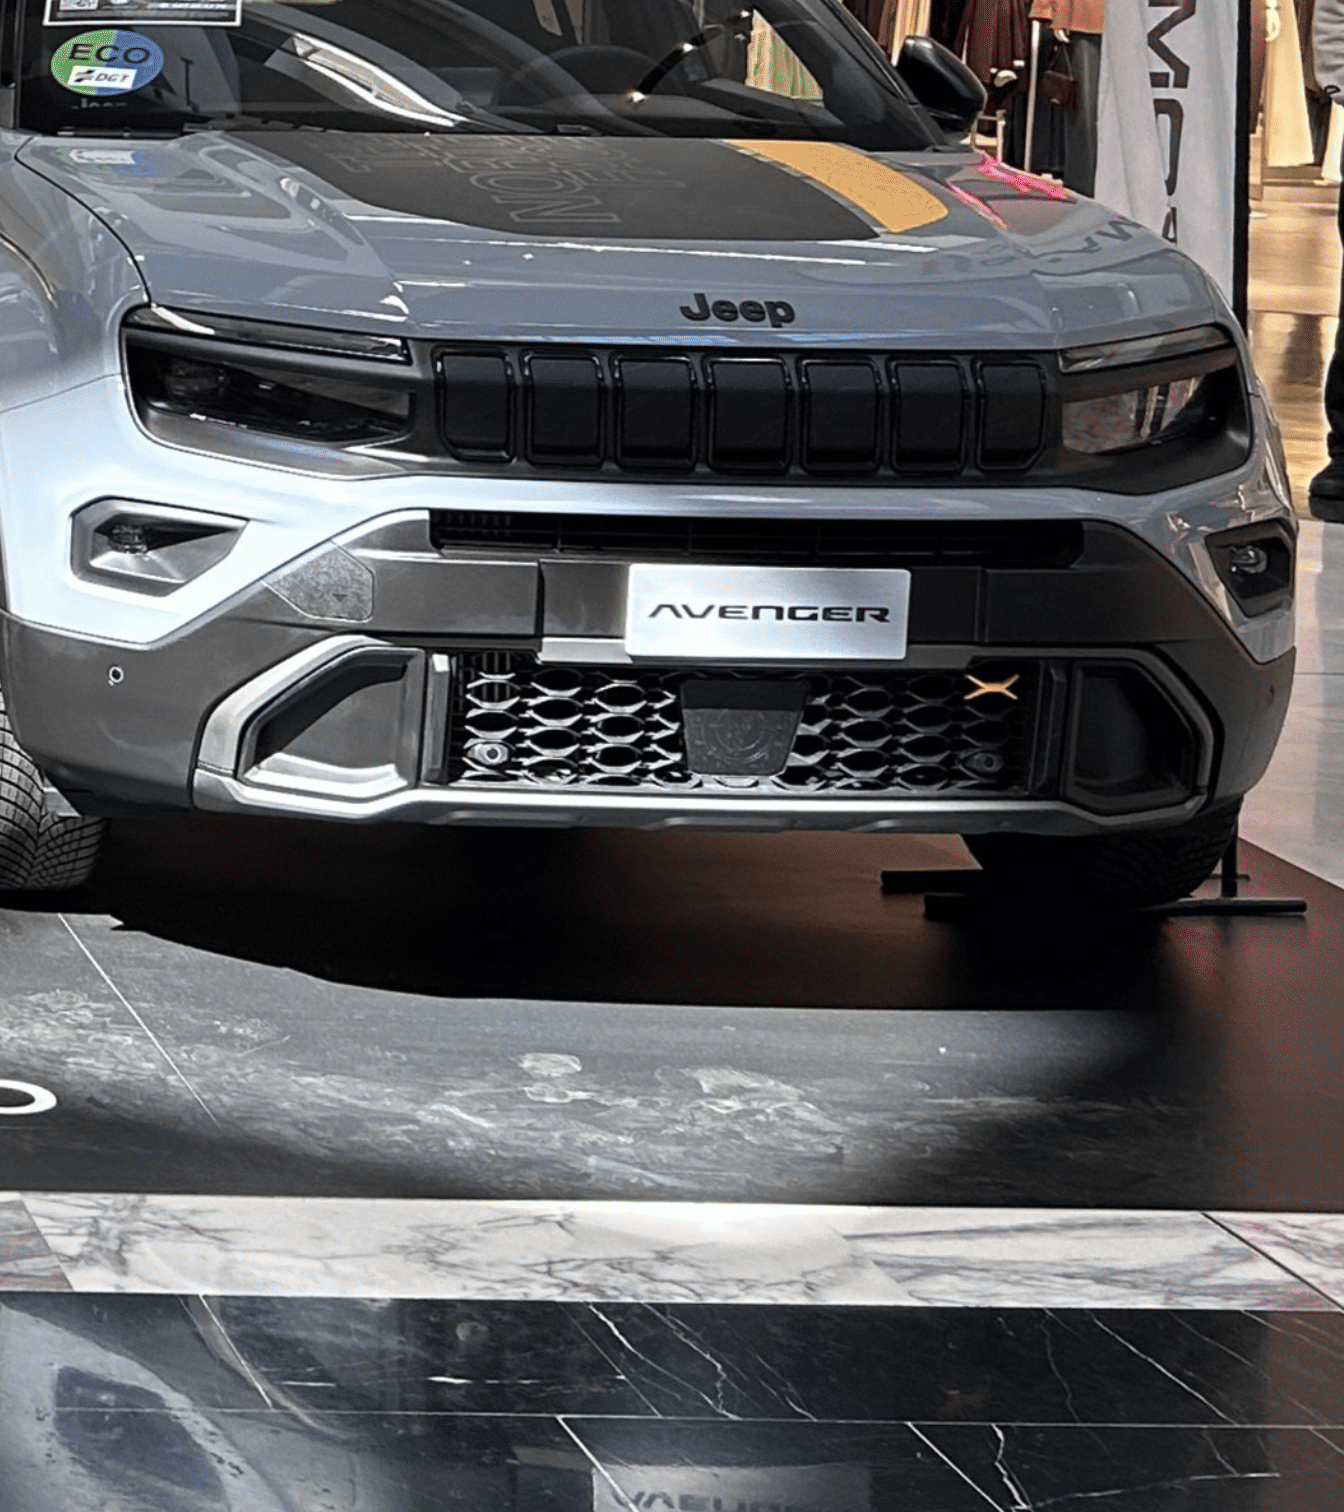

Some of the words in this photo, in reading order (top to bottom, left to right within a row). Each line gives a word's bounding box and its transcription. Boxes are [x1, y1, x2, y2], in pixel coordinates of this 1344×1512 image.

[68, 43, 151, 65] ECO
[95, 71, 131, 84] DGT
[679, 293, 796, 328] Jeep
[648, 603, 890, 623] AVENGER
